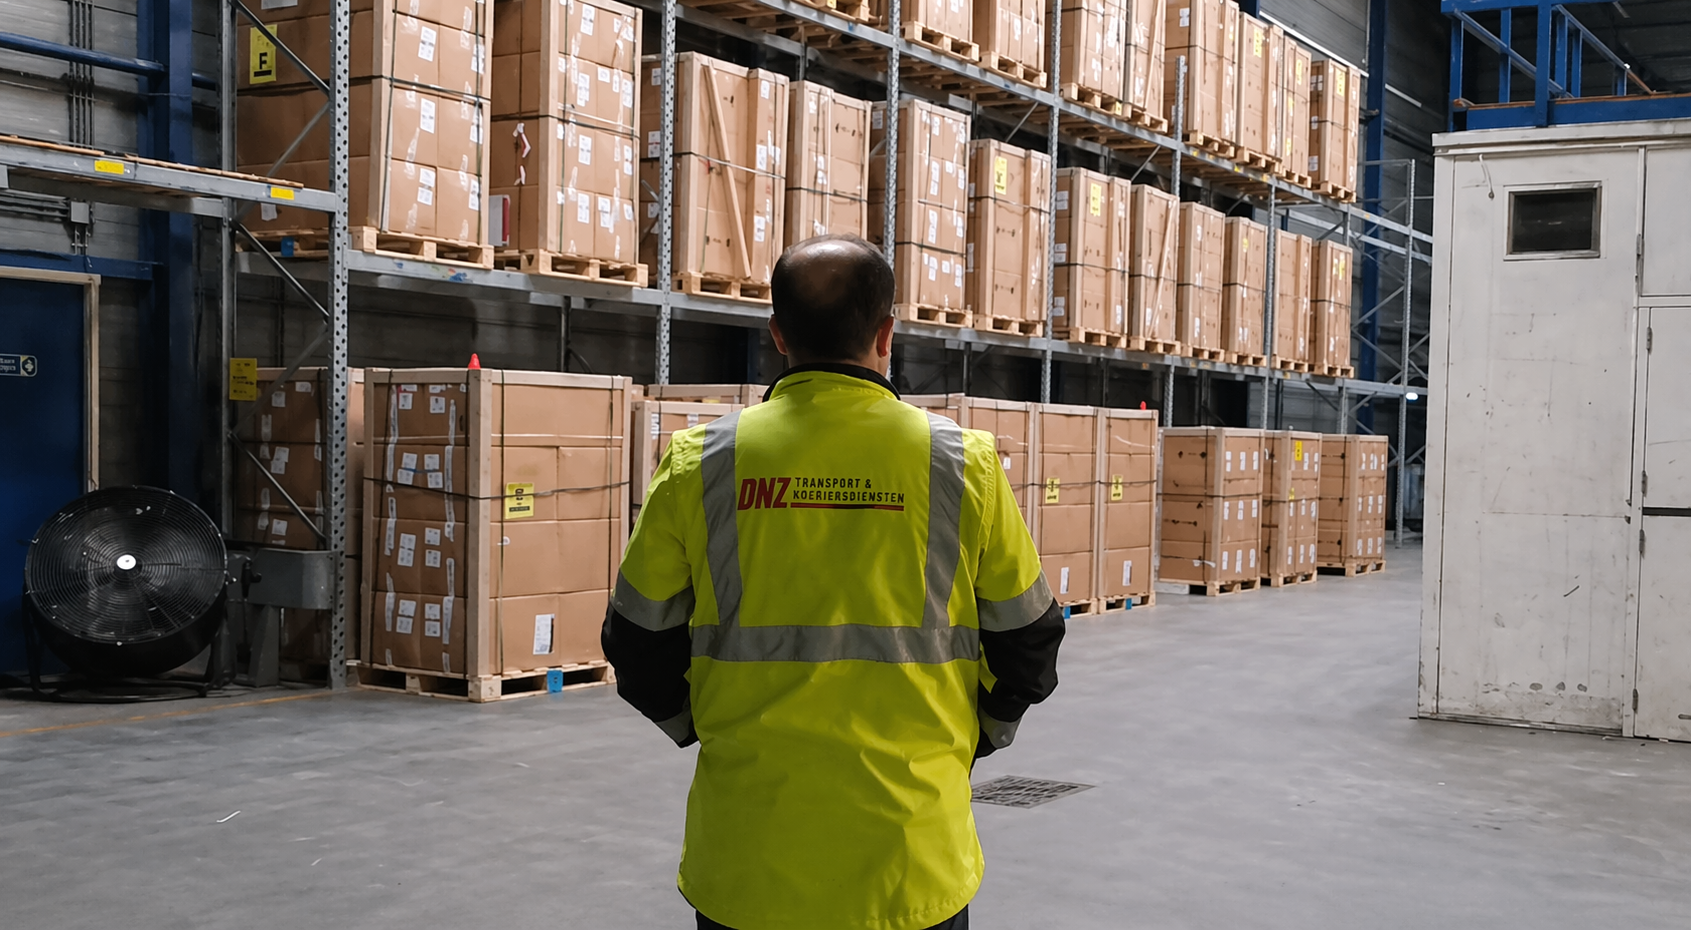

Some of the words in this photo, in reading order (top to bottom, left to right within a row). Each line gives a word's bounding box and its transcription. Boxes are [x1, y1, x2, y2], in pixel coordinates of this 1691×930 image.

[259, 52, 268, 69] F
[795, 477, 861, 489] TRANSPORT
[865, 479, 872, 489] &
[737, 477, 792, 511] DNZ
[793, 490, 905, 503] KOERIERSDIENSTEN
